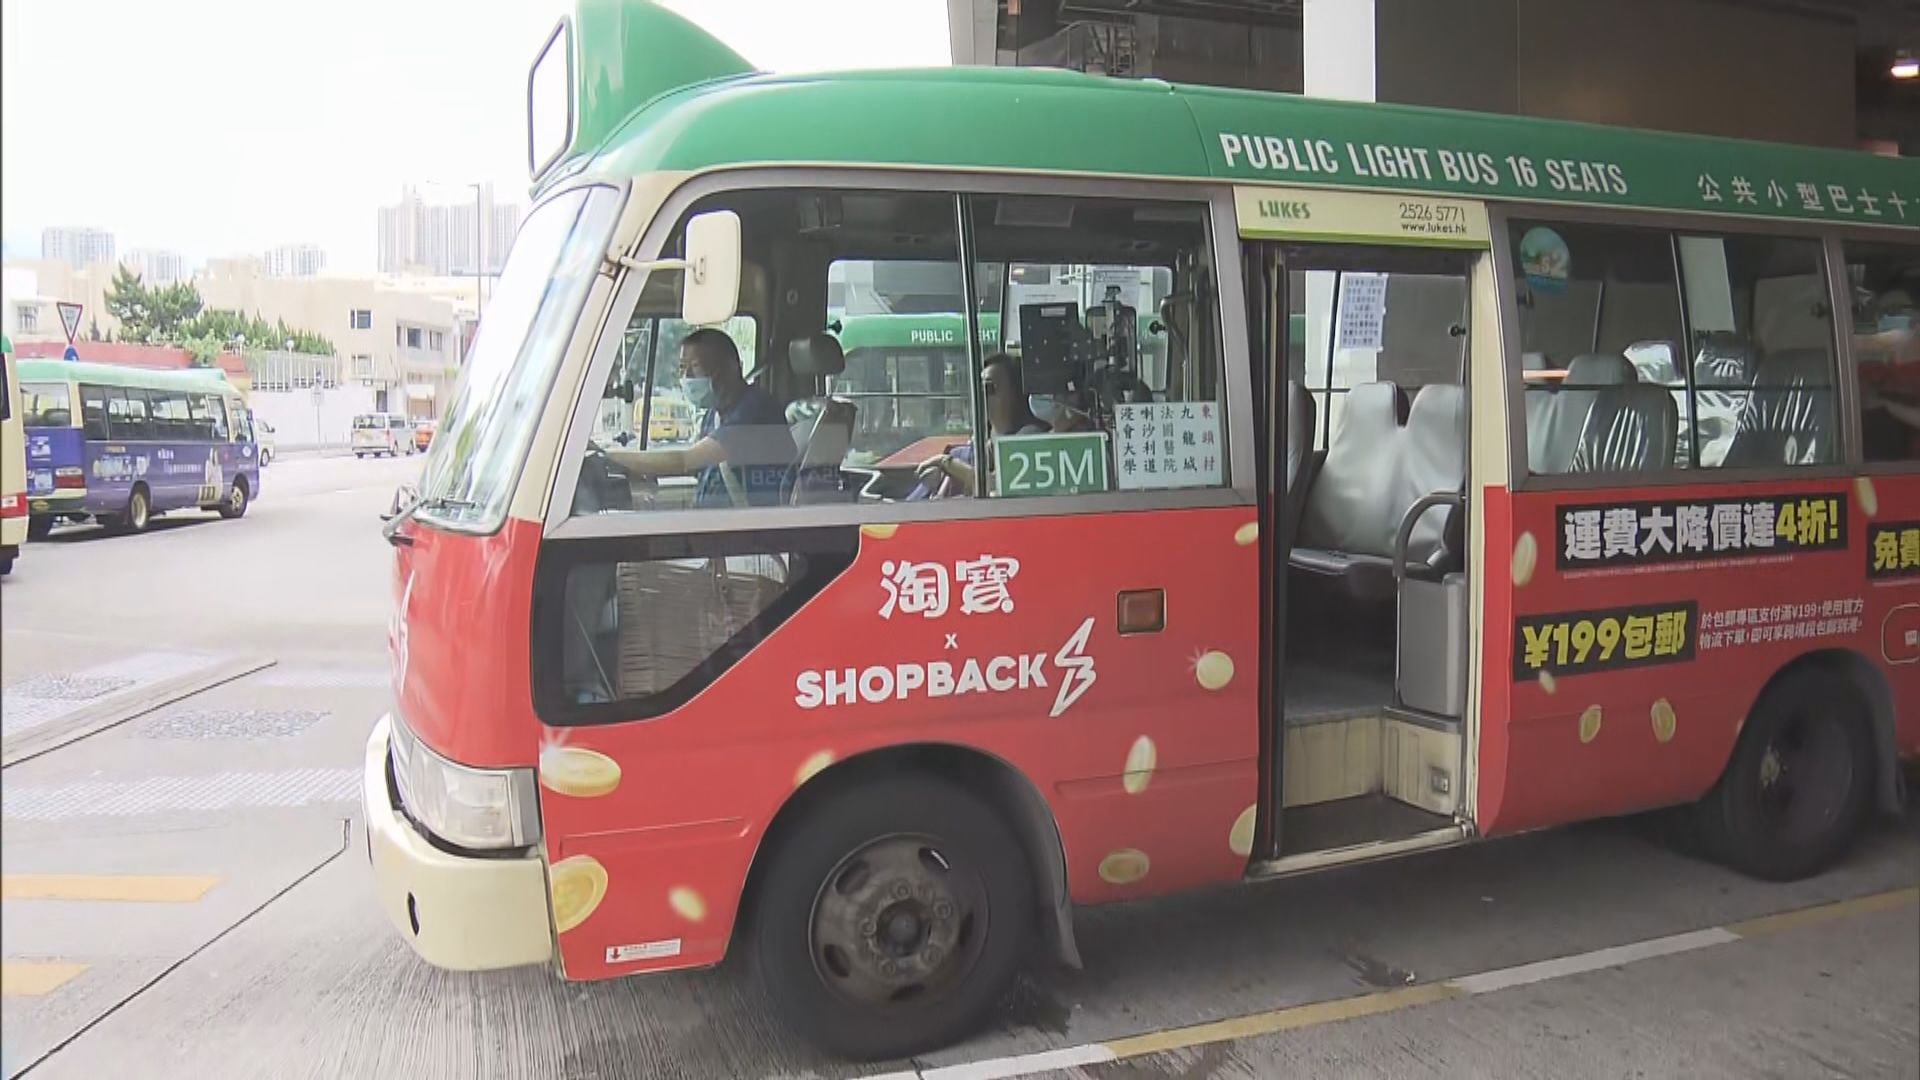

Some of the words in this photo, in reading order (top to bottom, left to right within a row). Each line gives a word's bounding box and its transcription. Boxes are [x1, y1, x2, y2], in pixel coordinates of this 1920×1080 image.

[1218, 133, 1339, 173] PUBLIC
[1345, 142, 1432, 180] LIGHT
[1437, 150, 1499, 186] BUS
[1505, 156, 1538, 188] 16
[1544, 159, 1628, 196] SEATS
[1258, 200, 1312, 220] LUKES
[1697, 173, 1920, 219] 公共小型巴士十
[1399, 202, 1433, 221] 2526
[1435, 205, 1466, 223] 5771
[1401, 222, 1468, 235] www.lukes.hk
[911, 329, 953, 343] PUBLIC
[1008, 448, 1095, 490] 25M
[794, 652, 1049, 709] SHOPBACK
